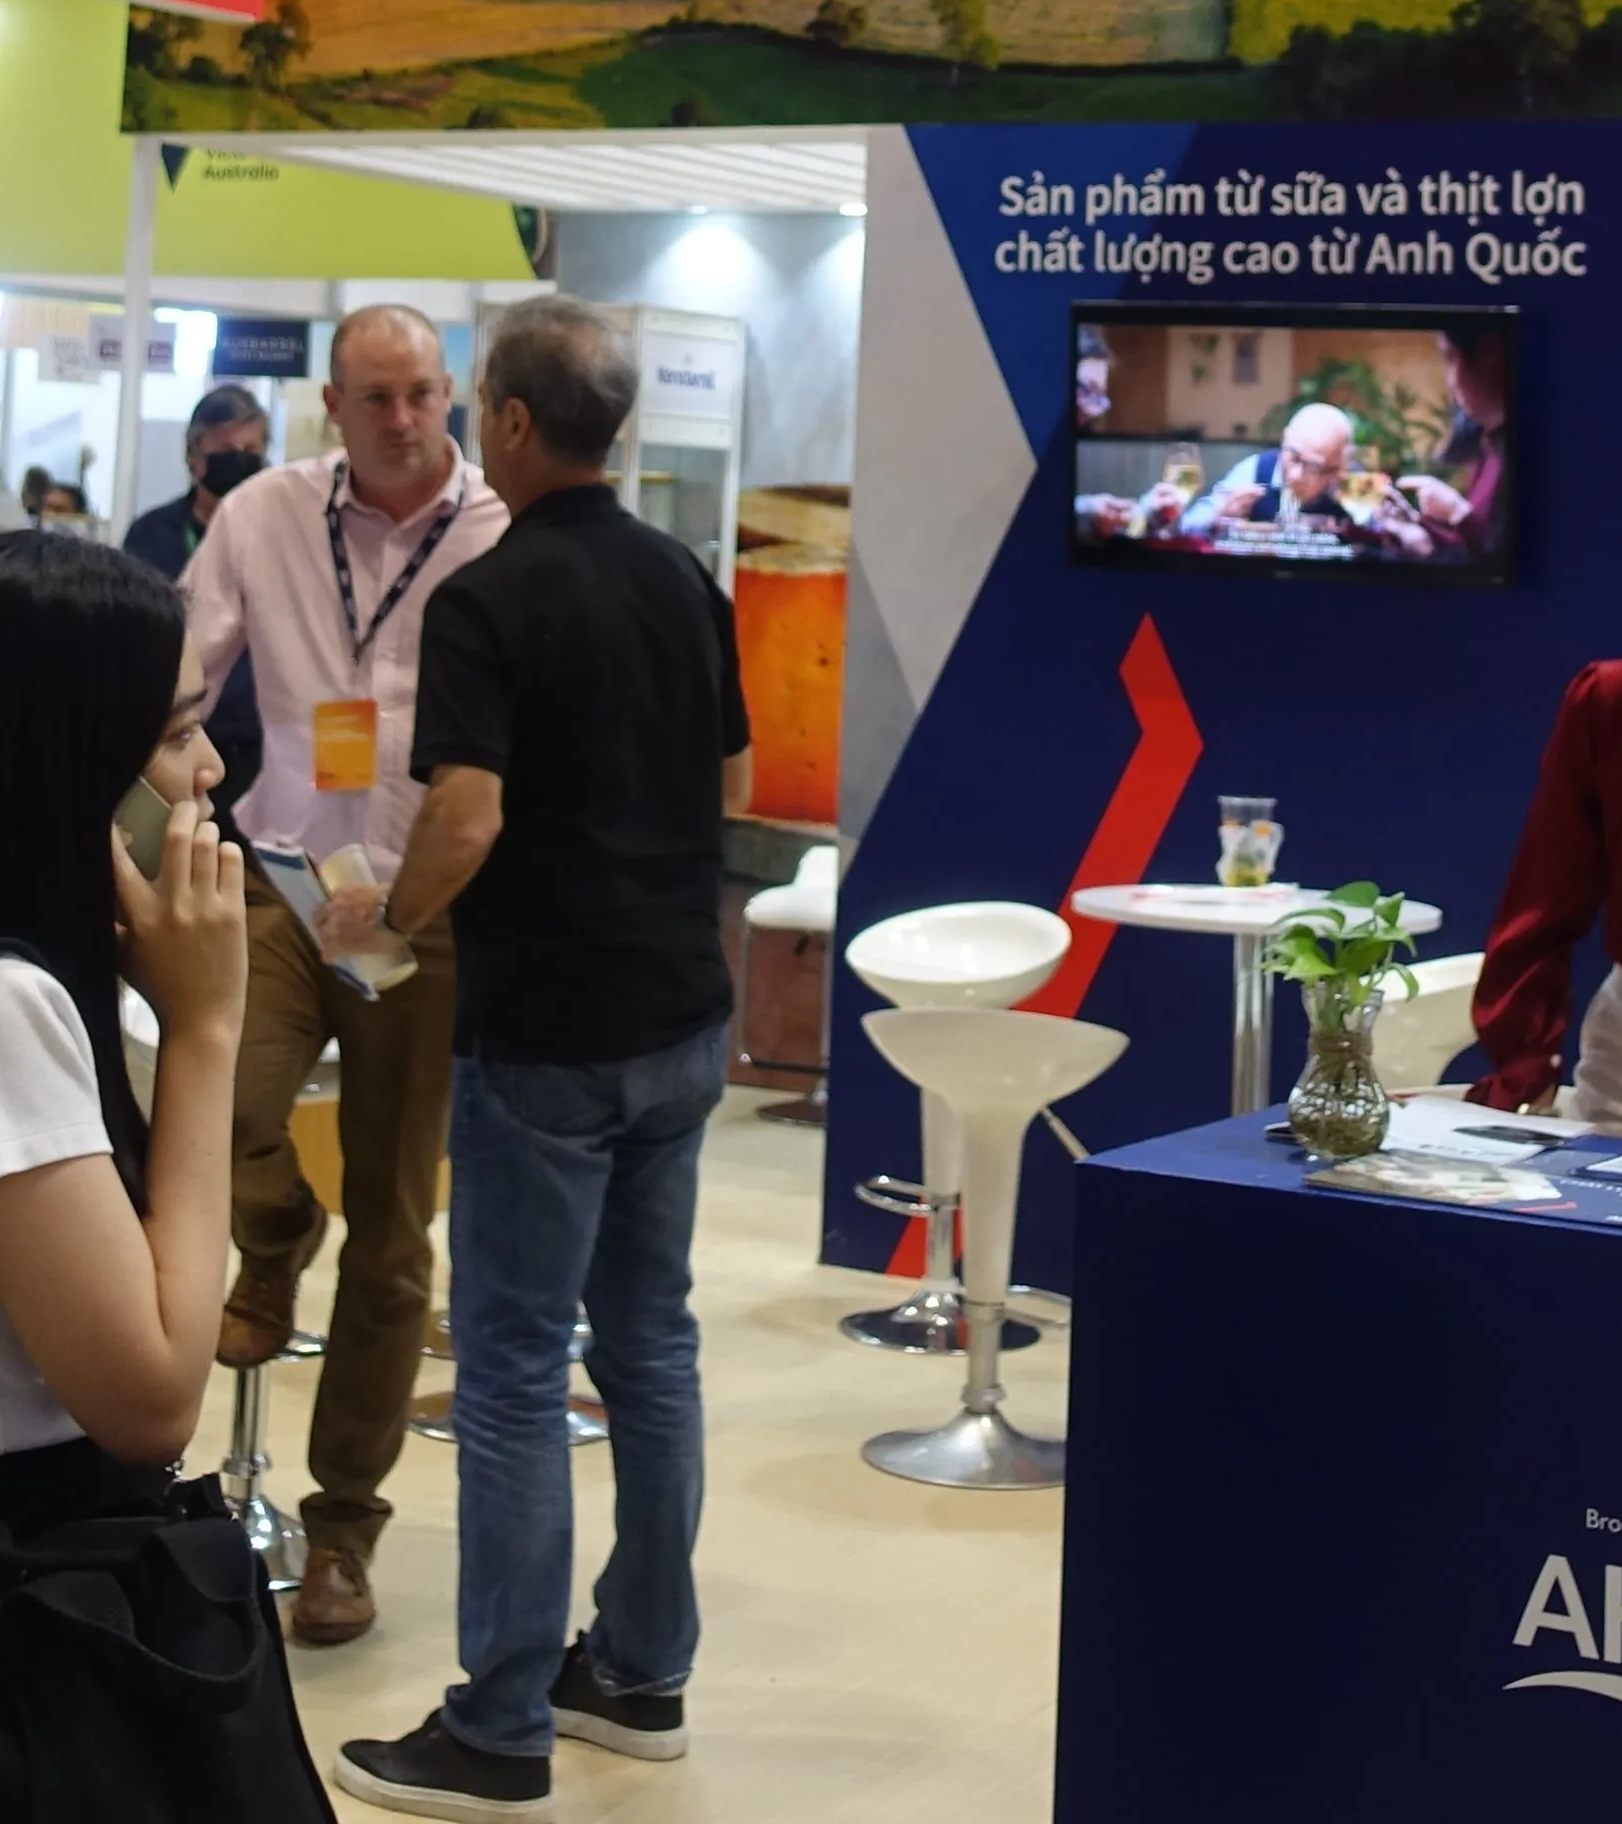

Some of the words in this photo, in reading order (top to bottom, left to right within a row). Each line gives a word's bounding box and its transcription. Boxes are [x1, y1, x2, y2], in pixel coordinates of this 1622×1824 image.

[203, 164, 280, 181] Australia
[999, 170, 1075, 217] Sản
[1085, 168, 1206, 226] phẩm
[1215, 168, 1266, 217] từ
[1270, 170, 1347, 216] sữa
[1355, 166, 1408, 216] và
[1417, 170, 1501, 227] thịt
[1511, 169, 1586, 227] lợn
[994, 226, 1085, 273] chất
[1094, 229, 1215, 285] lượng
[1222, 240, 1300, 274] cao
[1309, 226, 1361, 274] từ
[1365, 229, 1455, 274] Anh
[1465, 225, 1587, 285] Quốc
